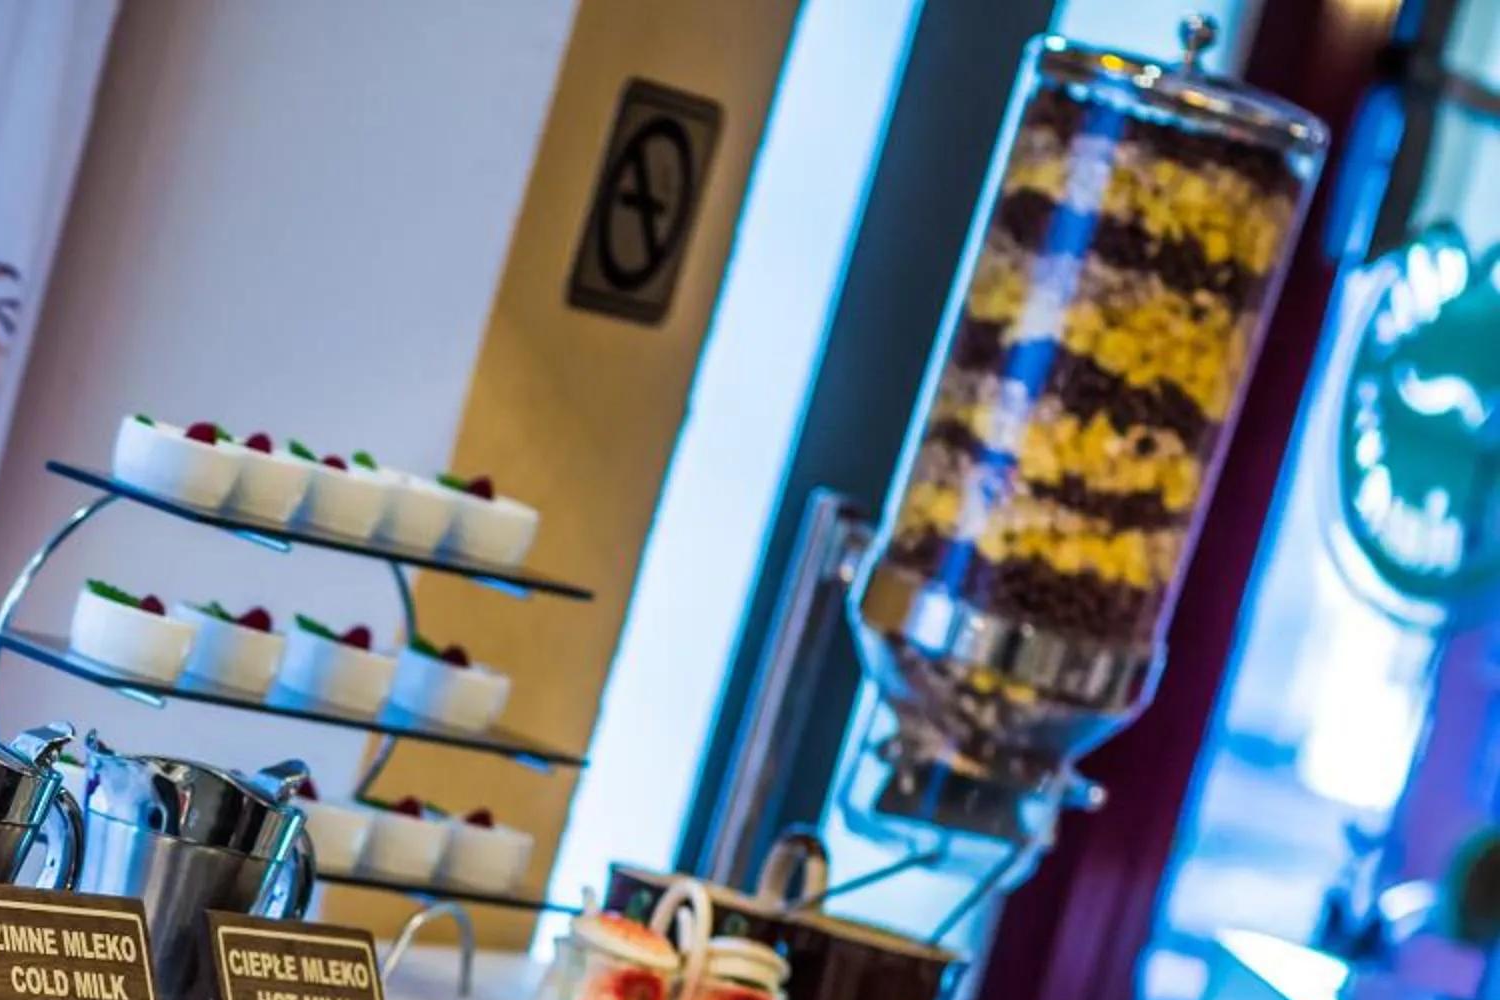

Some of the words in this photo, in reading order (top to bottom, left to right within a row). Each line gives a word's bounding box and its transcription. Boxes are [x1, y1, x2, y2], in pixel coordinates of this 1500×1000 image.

[61, 929, 137, 963] MLEKO
[11, 965, 69, 997] COLD
[228, 949, 298, 982] CIEPŁE
[301, 956, 369, 989] MLEKO
